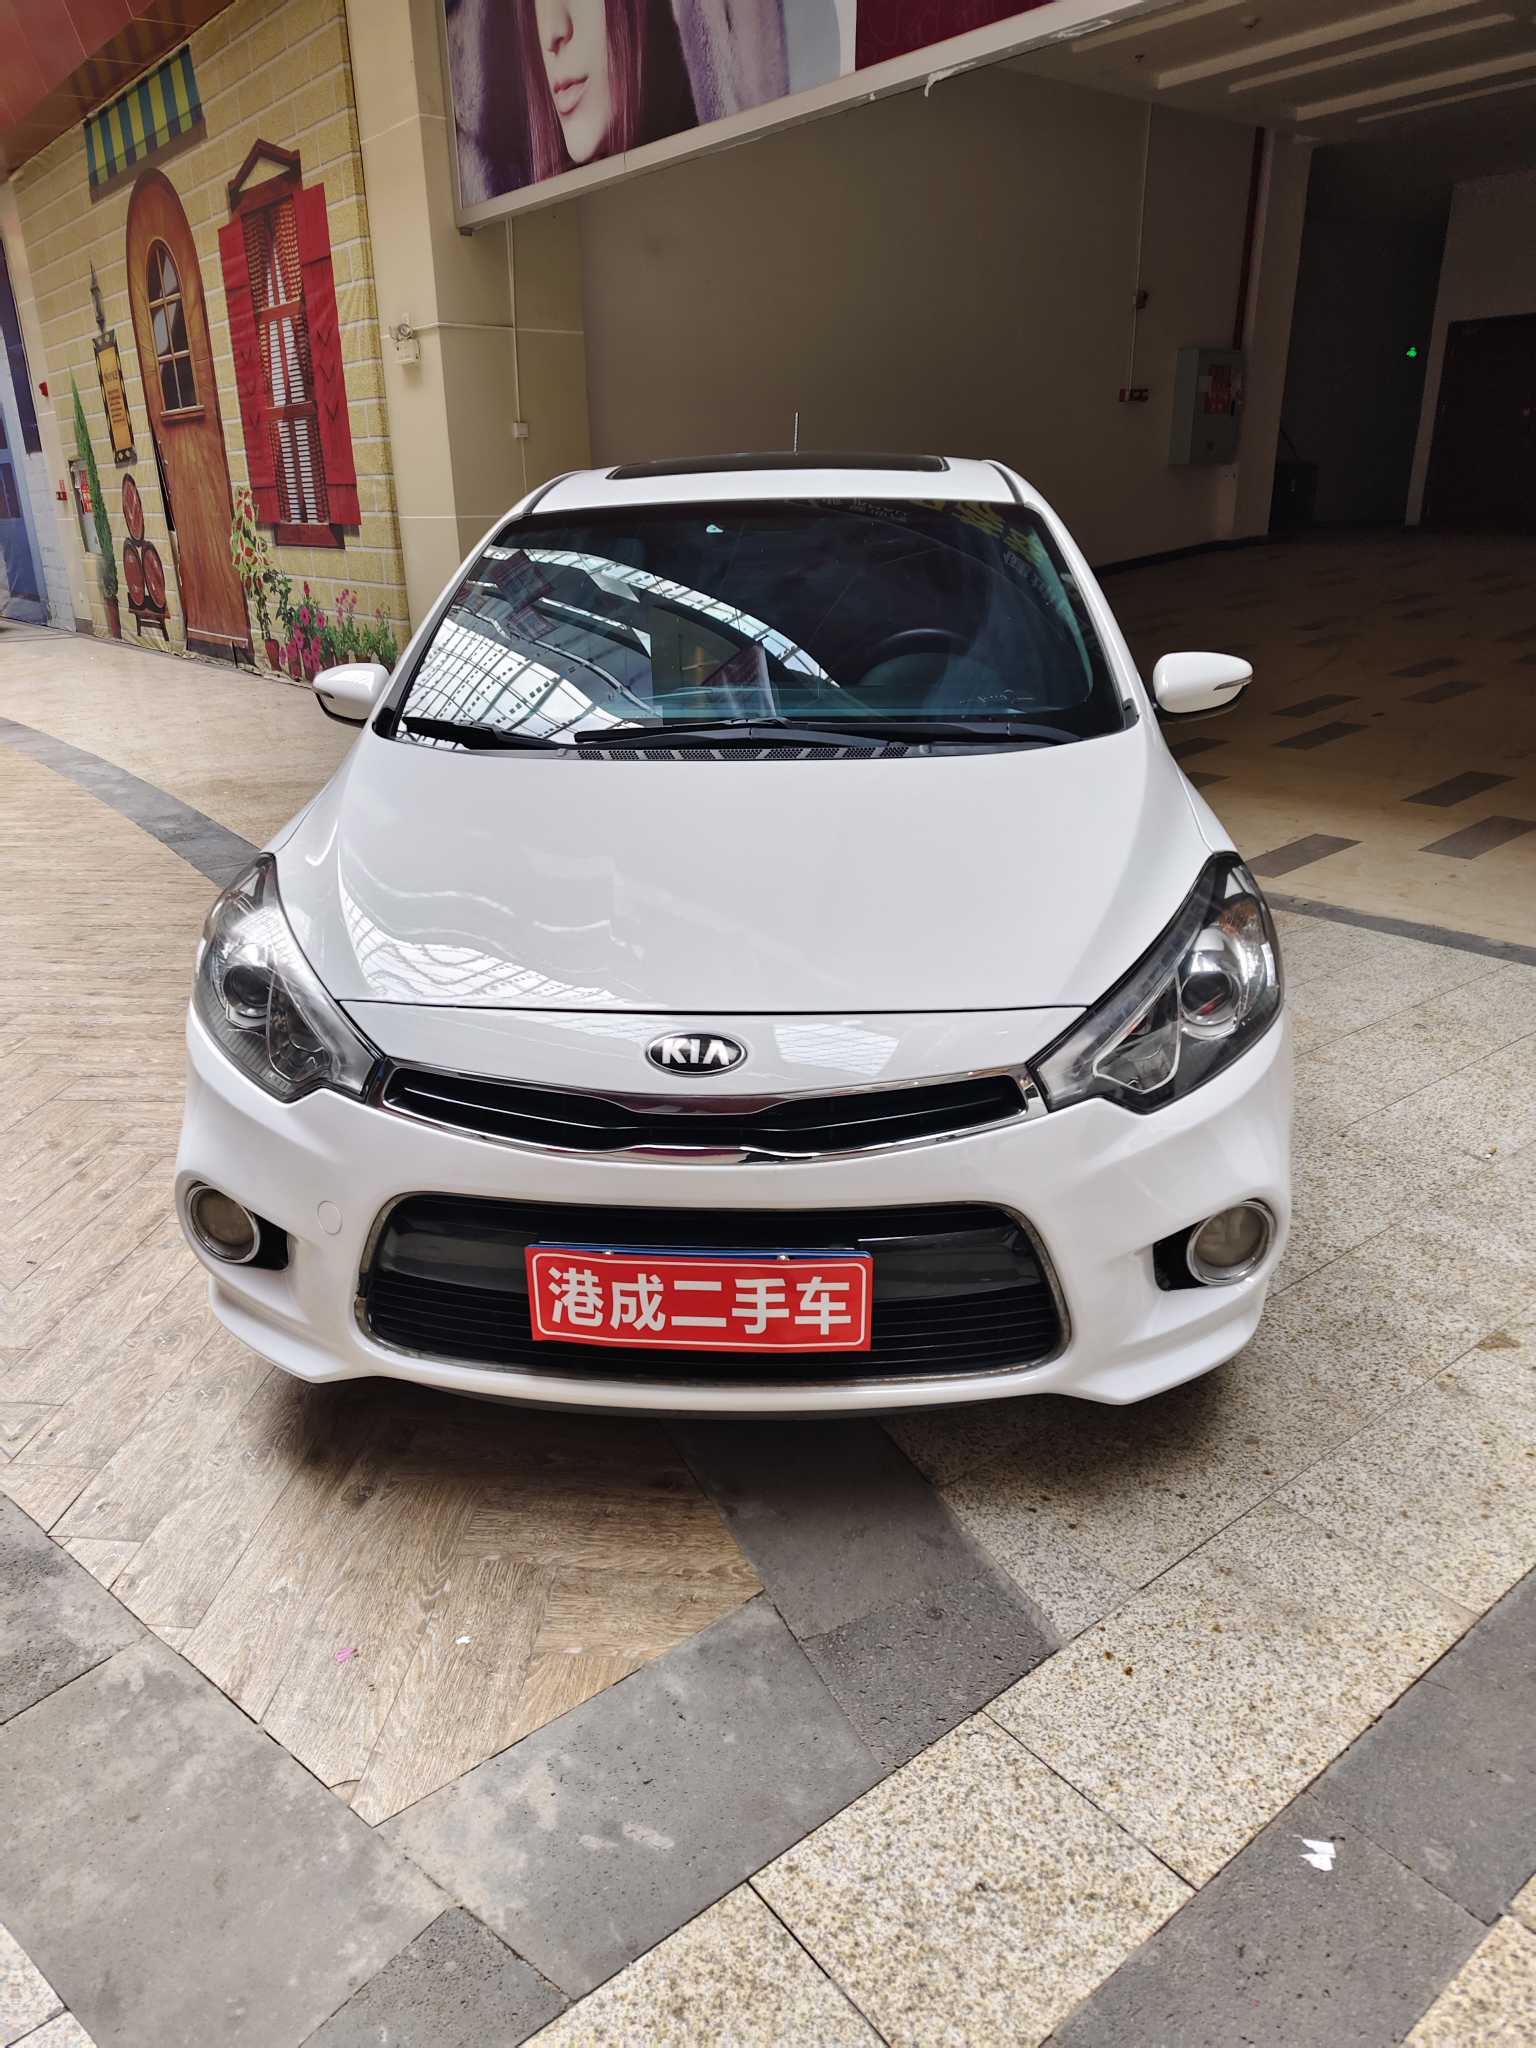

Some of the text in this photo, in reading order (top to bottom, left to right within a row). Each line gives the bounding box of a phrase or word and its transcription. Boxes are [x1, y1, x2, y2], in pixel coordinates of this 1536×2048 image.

[661, 1038, 730, 1065] KIA
[547, 1266, 852, 1336] 港成二手车
